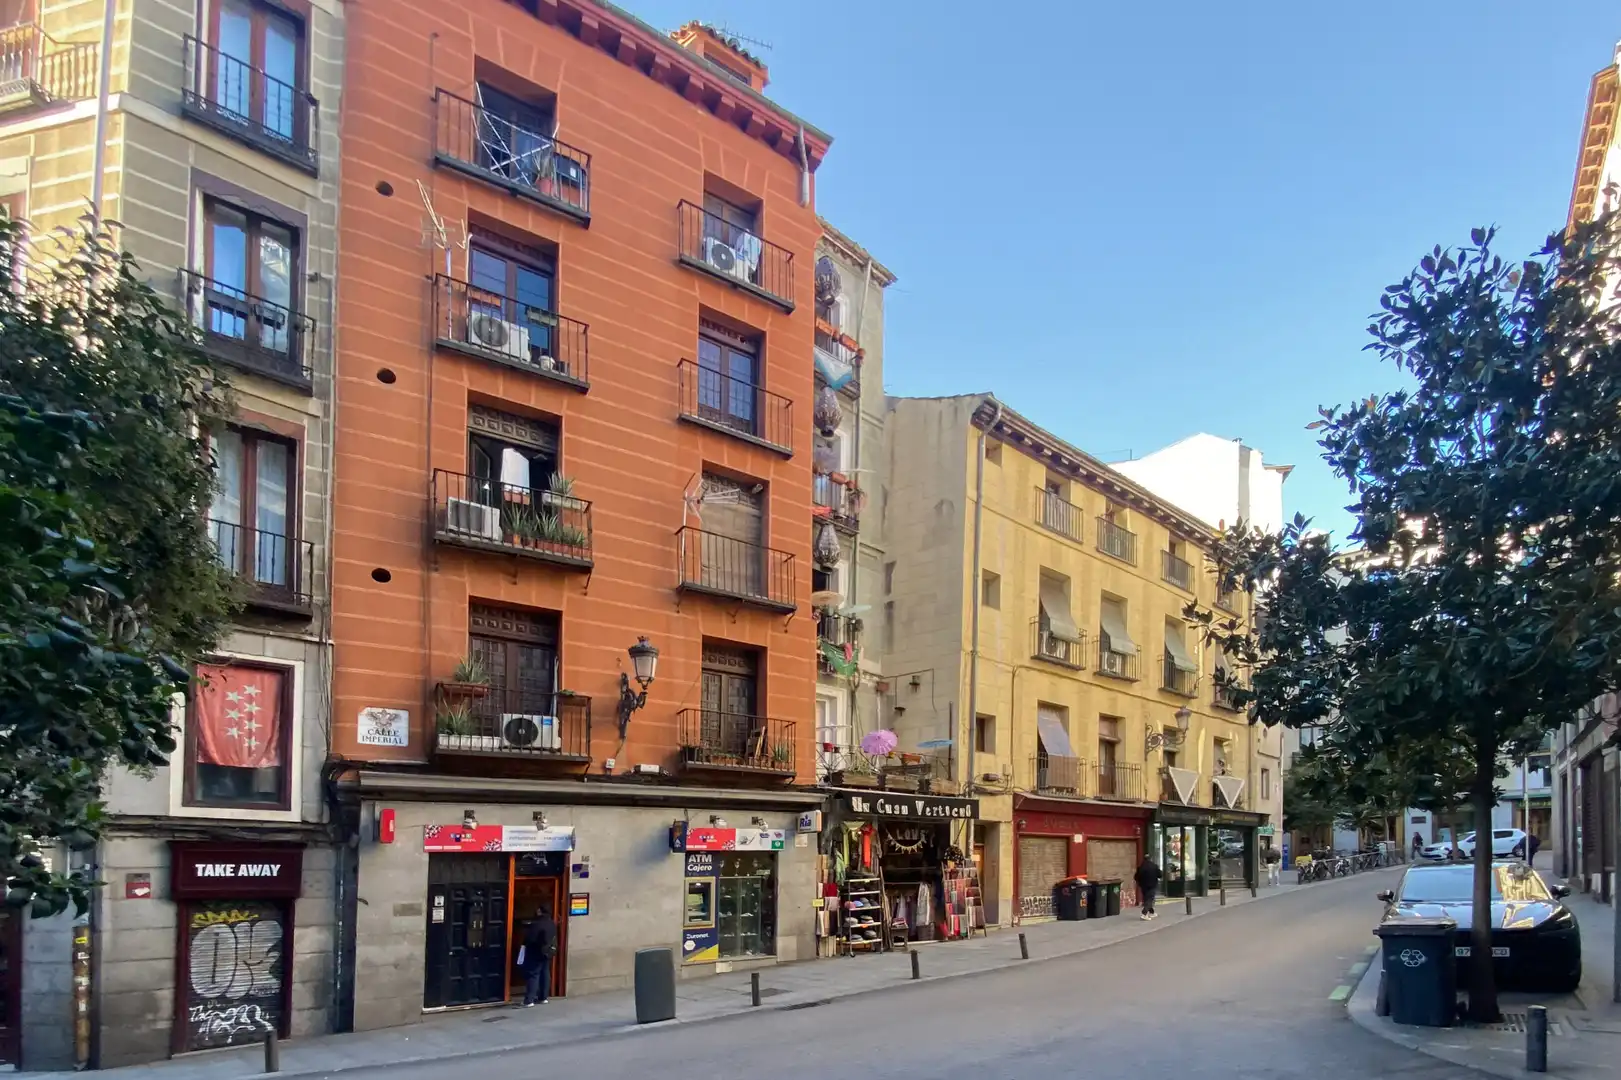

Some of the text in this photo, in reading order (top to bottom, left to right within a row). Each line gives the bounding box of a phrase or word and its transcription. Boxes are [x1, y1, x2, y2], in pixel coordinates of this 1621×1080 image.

[367, 728, 401, 738] CALLE
[362, 735, 404, 745] IMPERIAL
[799, 813, 812, 828] Ria
[688, 854, 713, 863] ATM
[195, 863, 281, 877] TAKE AWAY
[687, 864, 713, 873] Cajero
